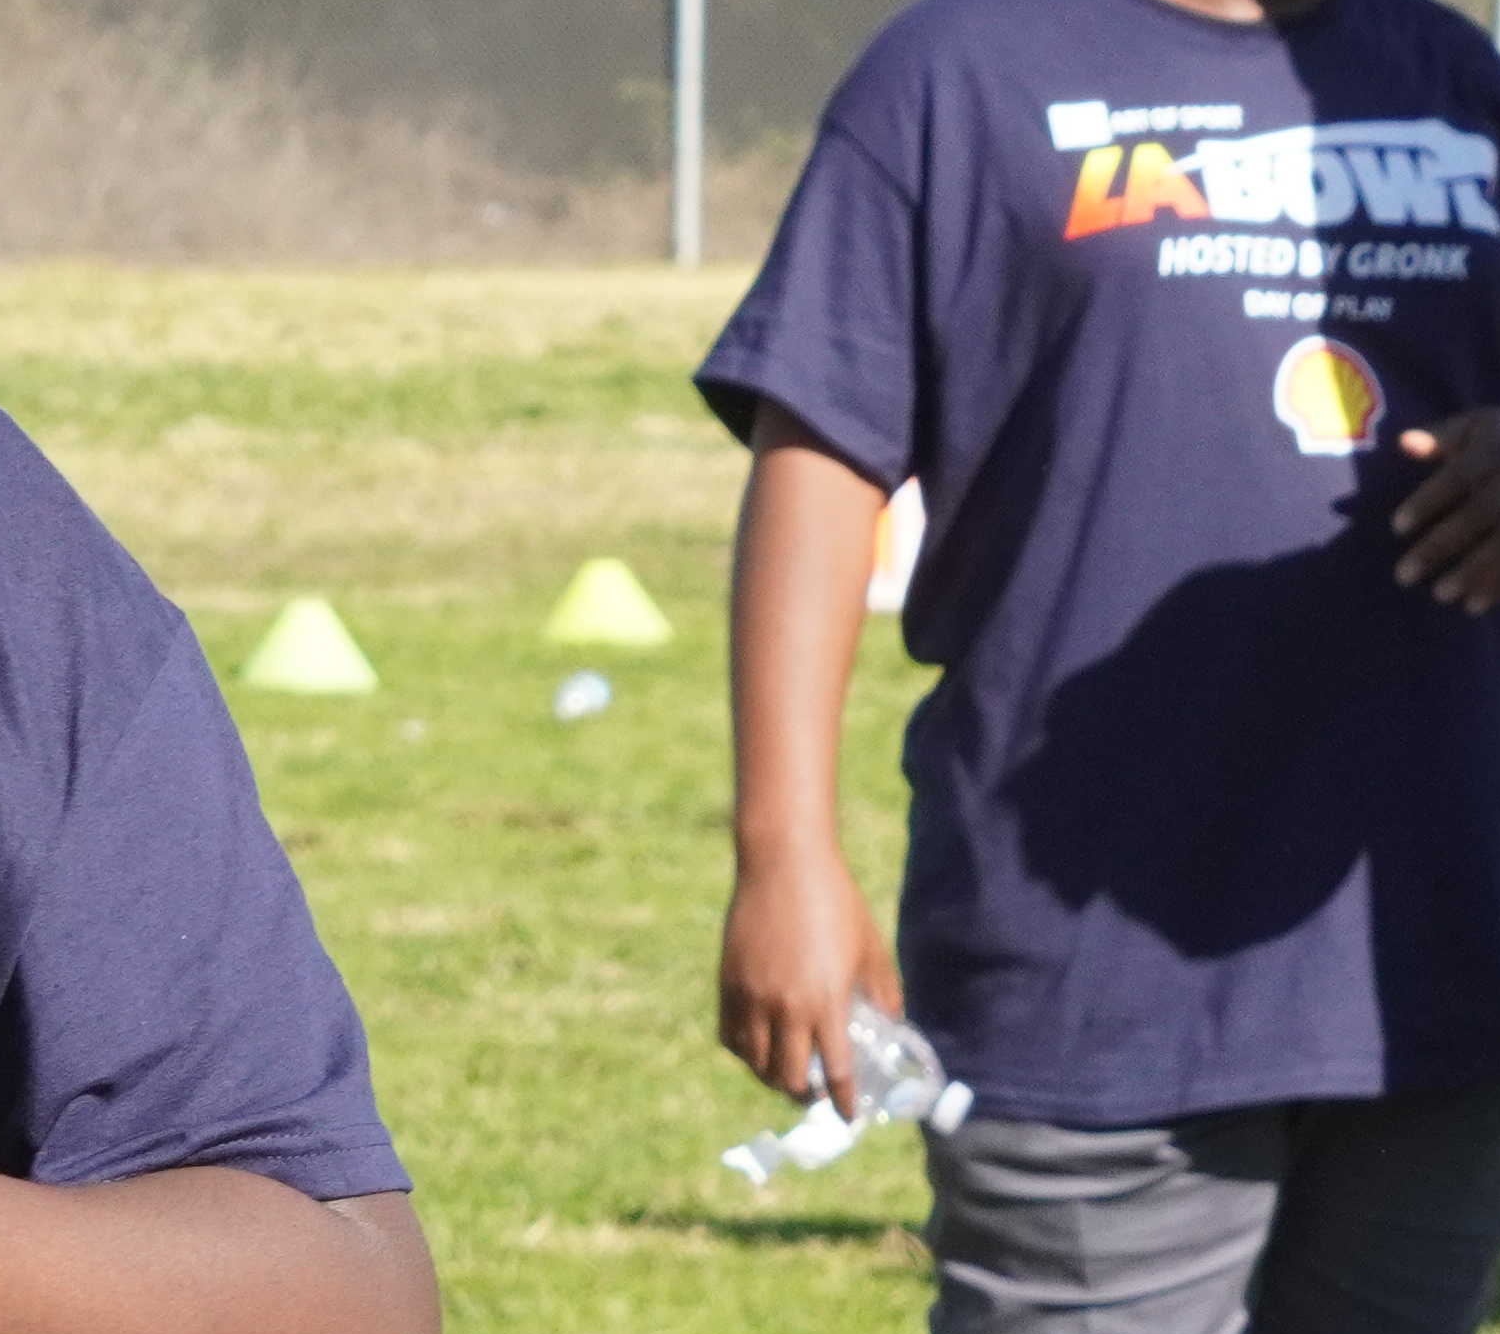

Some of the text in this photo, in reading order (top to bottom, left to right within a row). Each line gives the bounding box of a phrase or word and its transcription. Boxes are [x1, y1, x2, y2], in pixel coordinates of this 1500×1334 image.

[1063, 142, 1211, 242] LA
[1157, 233, 1297, 278] HOSTED
[1298, 238, 1346, 279] BY
